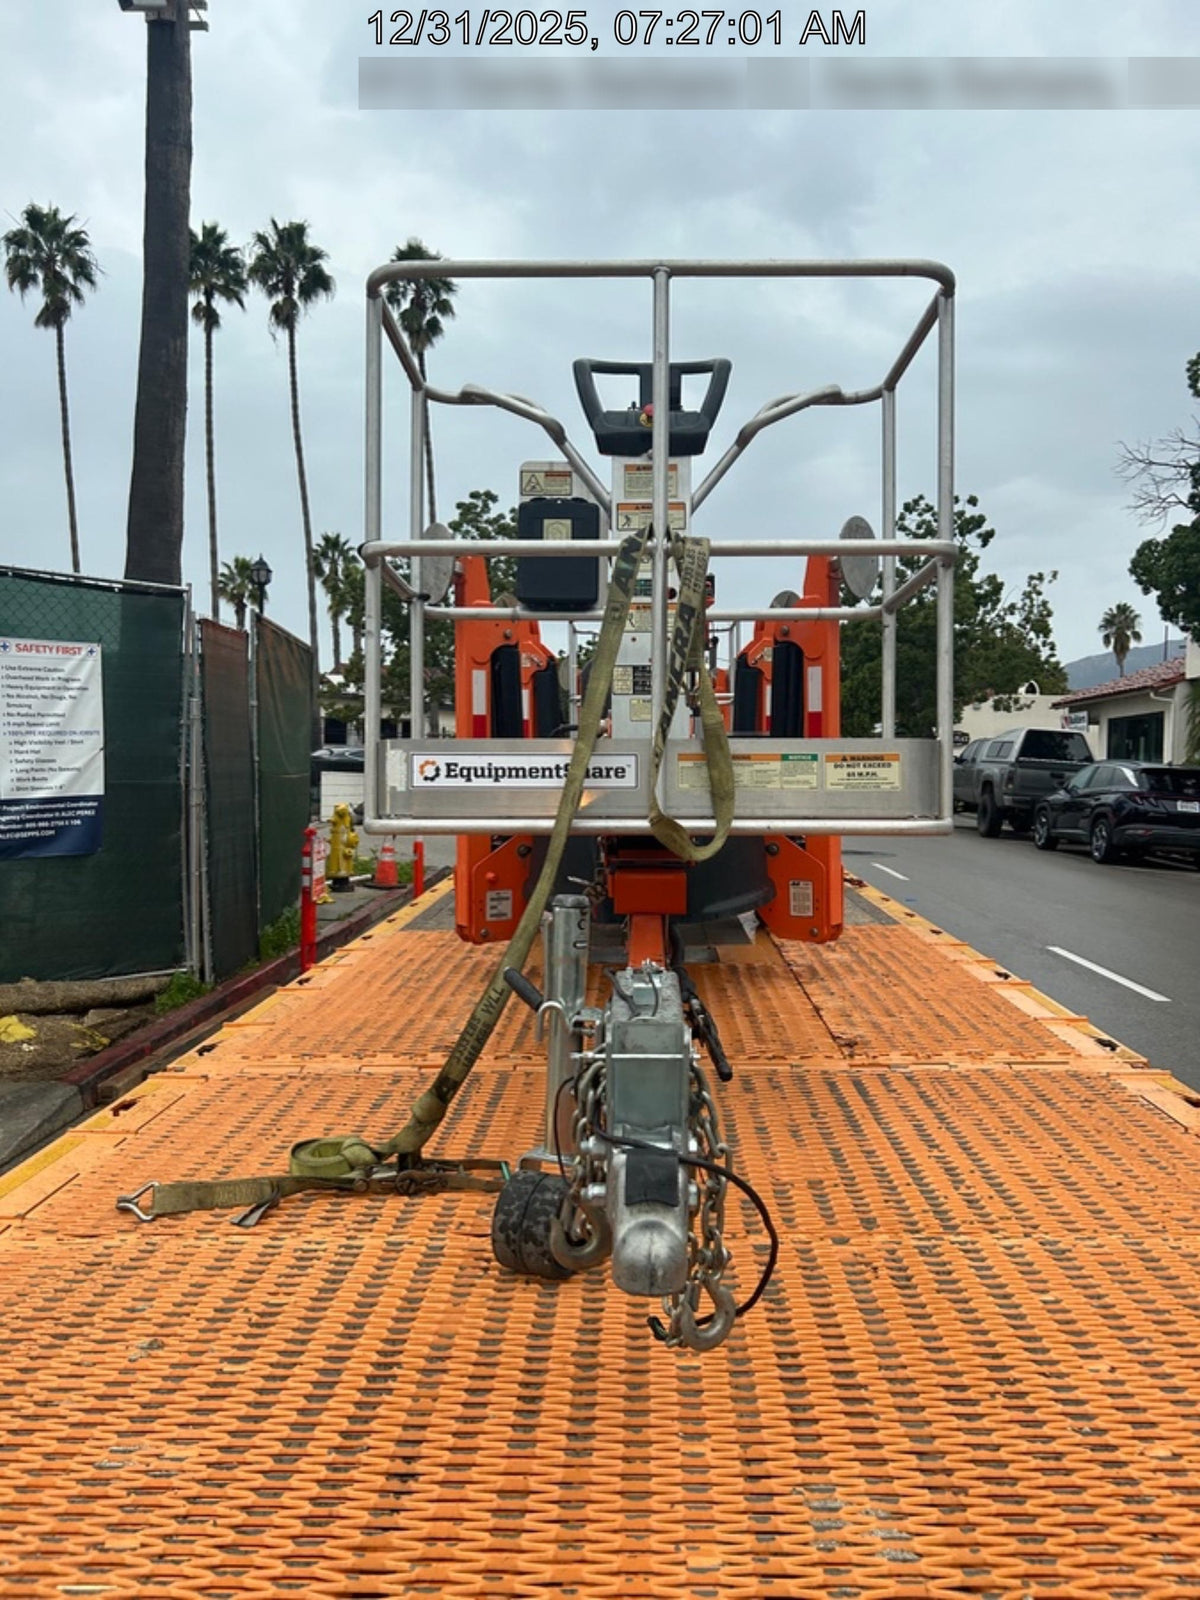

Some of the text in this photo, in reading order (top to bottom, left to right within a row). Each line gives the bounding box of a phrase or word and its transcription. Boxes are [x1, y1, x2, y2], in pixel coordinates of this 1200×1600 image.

[15, 643, 83, 655] SAFETY FIRST
[444, 761, 627, 783] Equipmentare
[481, 987, 506, 1015] WLL
